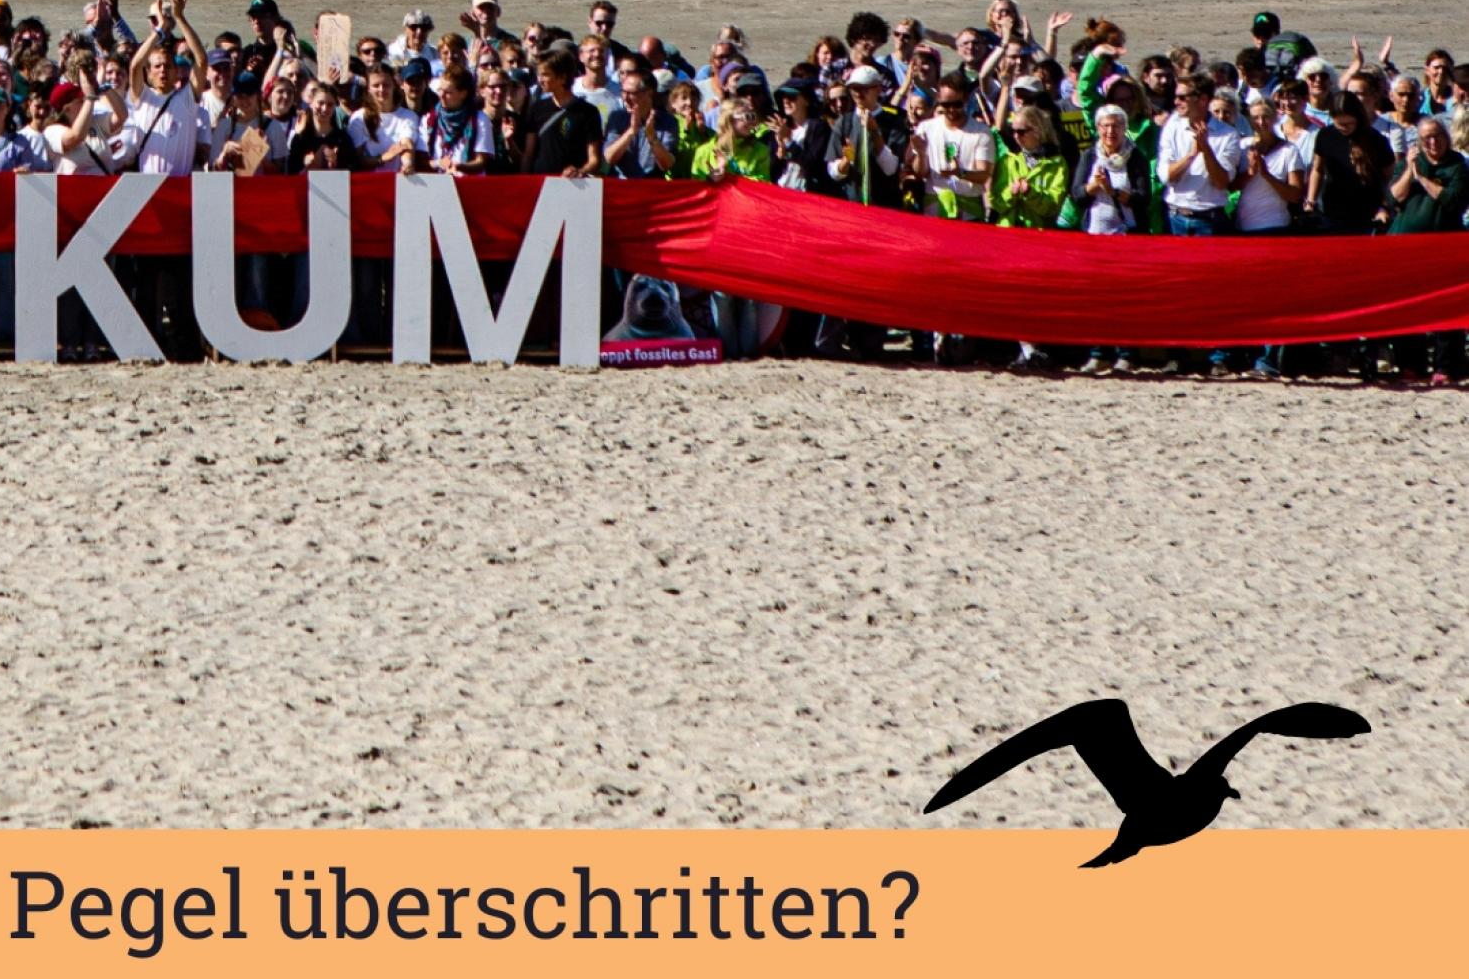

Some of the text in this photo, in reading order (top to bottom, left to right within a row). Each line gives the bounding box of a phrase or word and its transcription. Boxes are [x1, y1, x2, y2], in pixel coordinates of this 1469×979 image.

[598, 347, 718, 363] oppt fossiles Gas!
